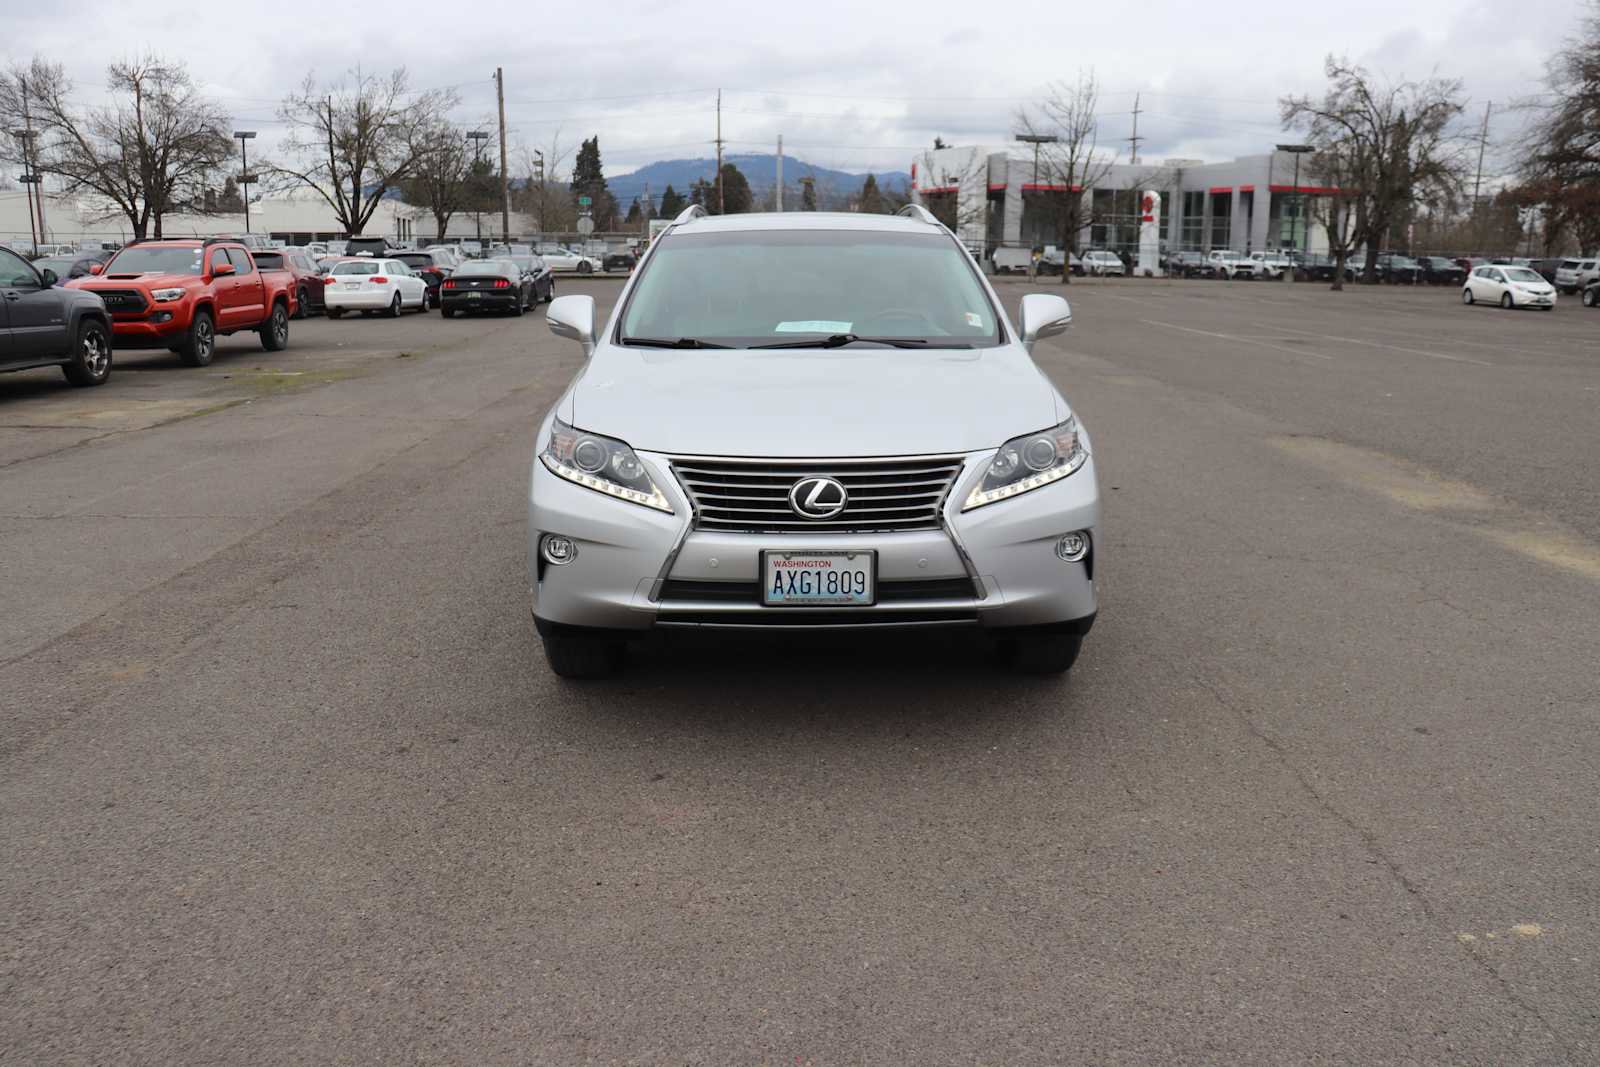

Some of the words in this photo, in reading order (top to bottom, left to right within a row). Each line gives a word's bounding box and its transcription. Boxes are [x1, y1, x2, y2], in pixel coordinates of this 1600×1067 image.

[102, 296, 124, 304] YOTA
[773, 560, 832, 568] WASHINGTON
[773, 570, 866, 595] AXG1809
